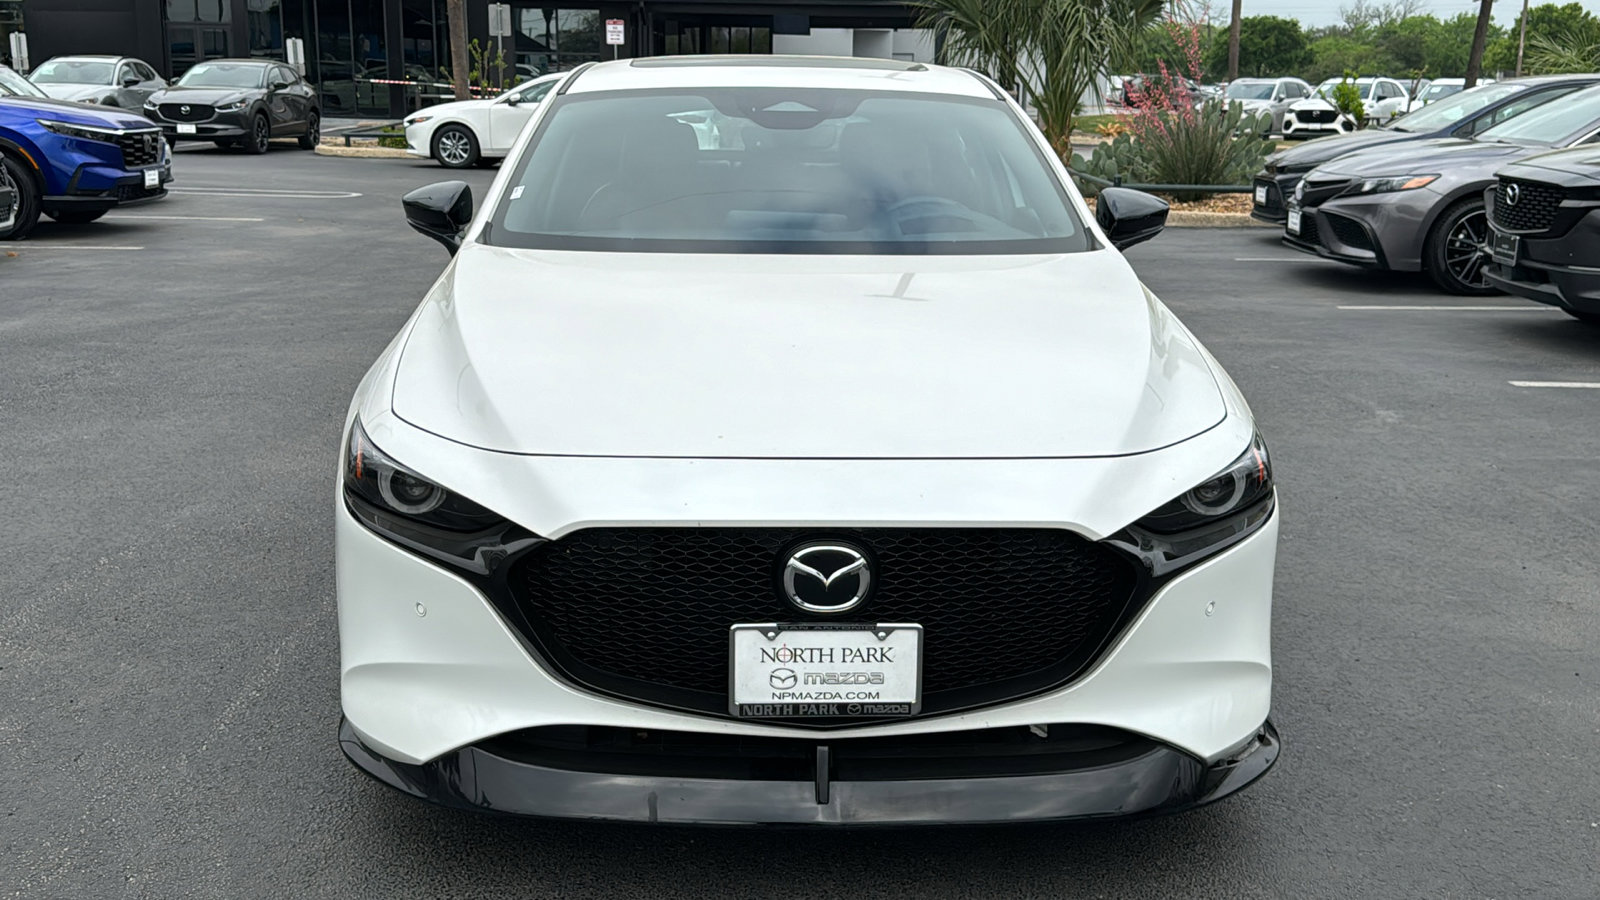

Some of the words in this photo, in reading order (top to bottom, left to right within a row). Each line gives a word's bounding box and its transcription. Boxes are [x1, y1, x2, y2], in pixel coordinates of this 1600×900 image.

[760, 646, 834, 664] NORTH
[841, 647, 894, 663] PARK
[771, 692, 880, 700] NPMAZDA.COM
[742, 704, 793, 716] NORTH
[800, 704, 840, 716] PARK
